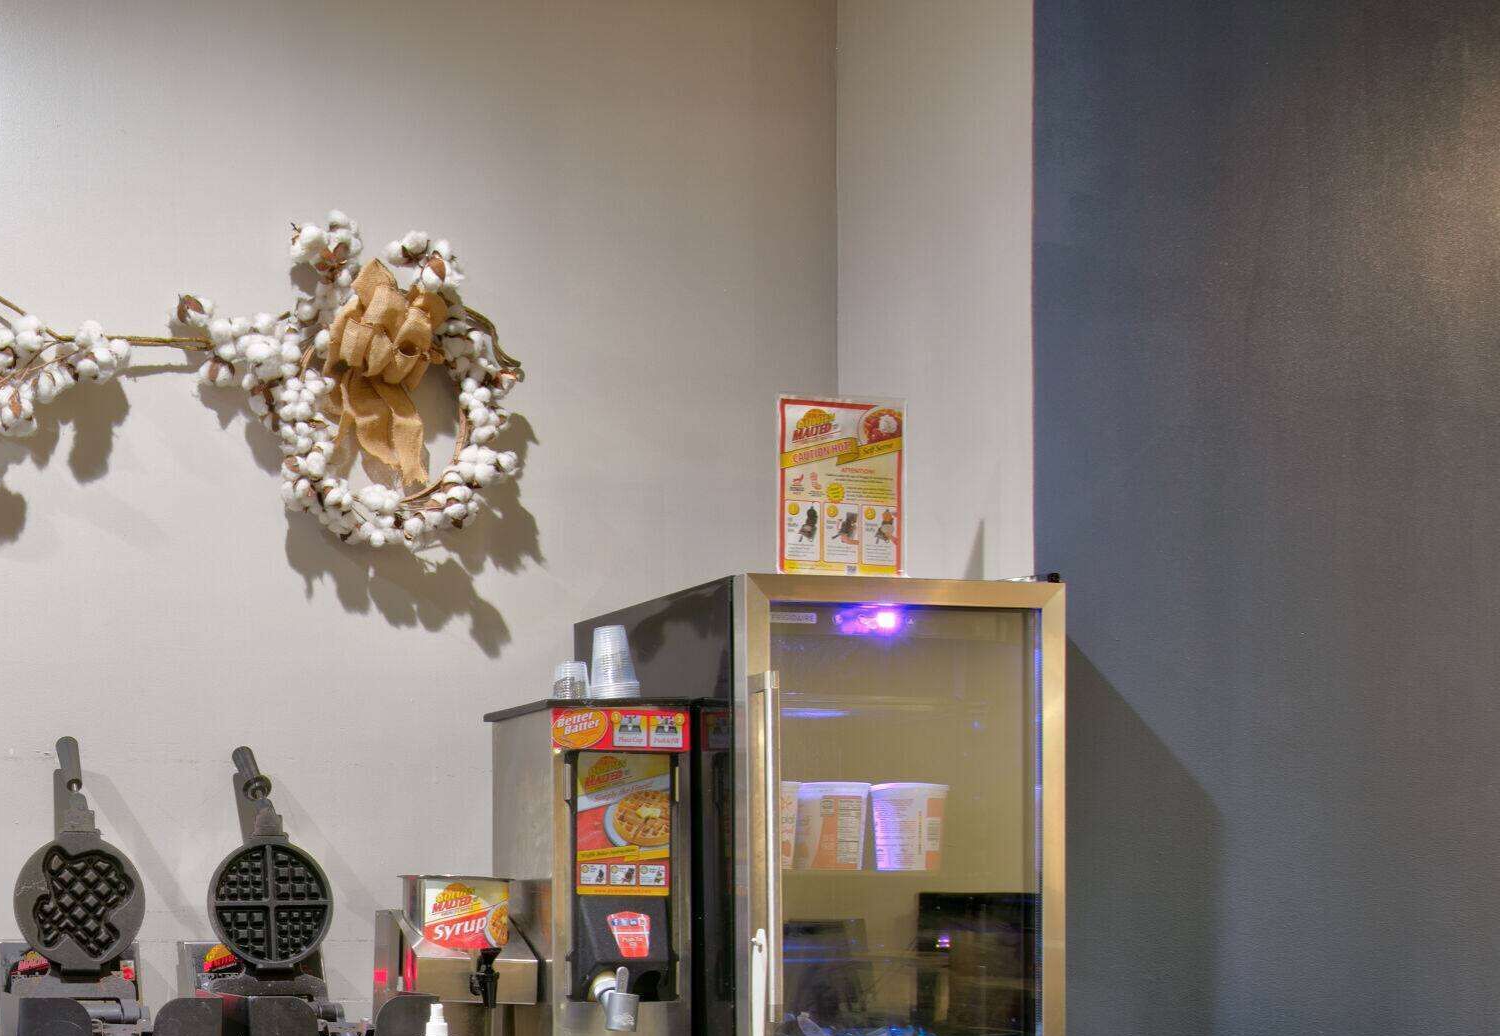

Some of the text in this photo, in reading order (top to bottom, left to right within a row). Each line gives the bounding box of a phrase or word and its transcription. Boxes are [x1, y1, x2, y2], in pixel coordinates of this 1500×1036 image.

[557, 712, 593, 728] Better
[564, 720, 600, 735] Batter
[432, 896, 472, 913] MALTED
[433, 917, 487, 940] Syrup
